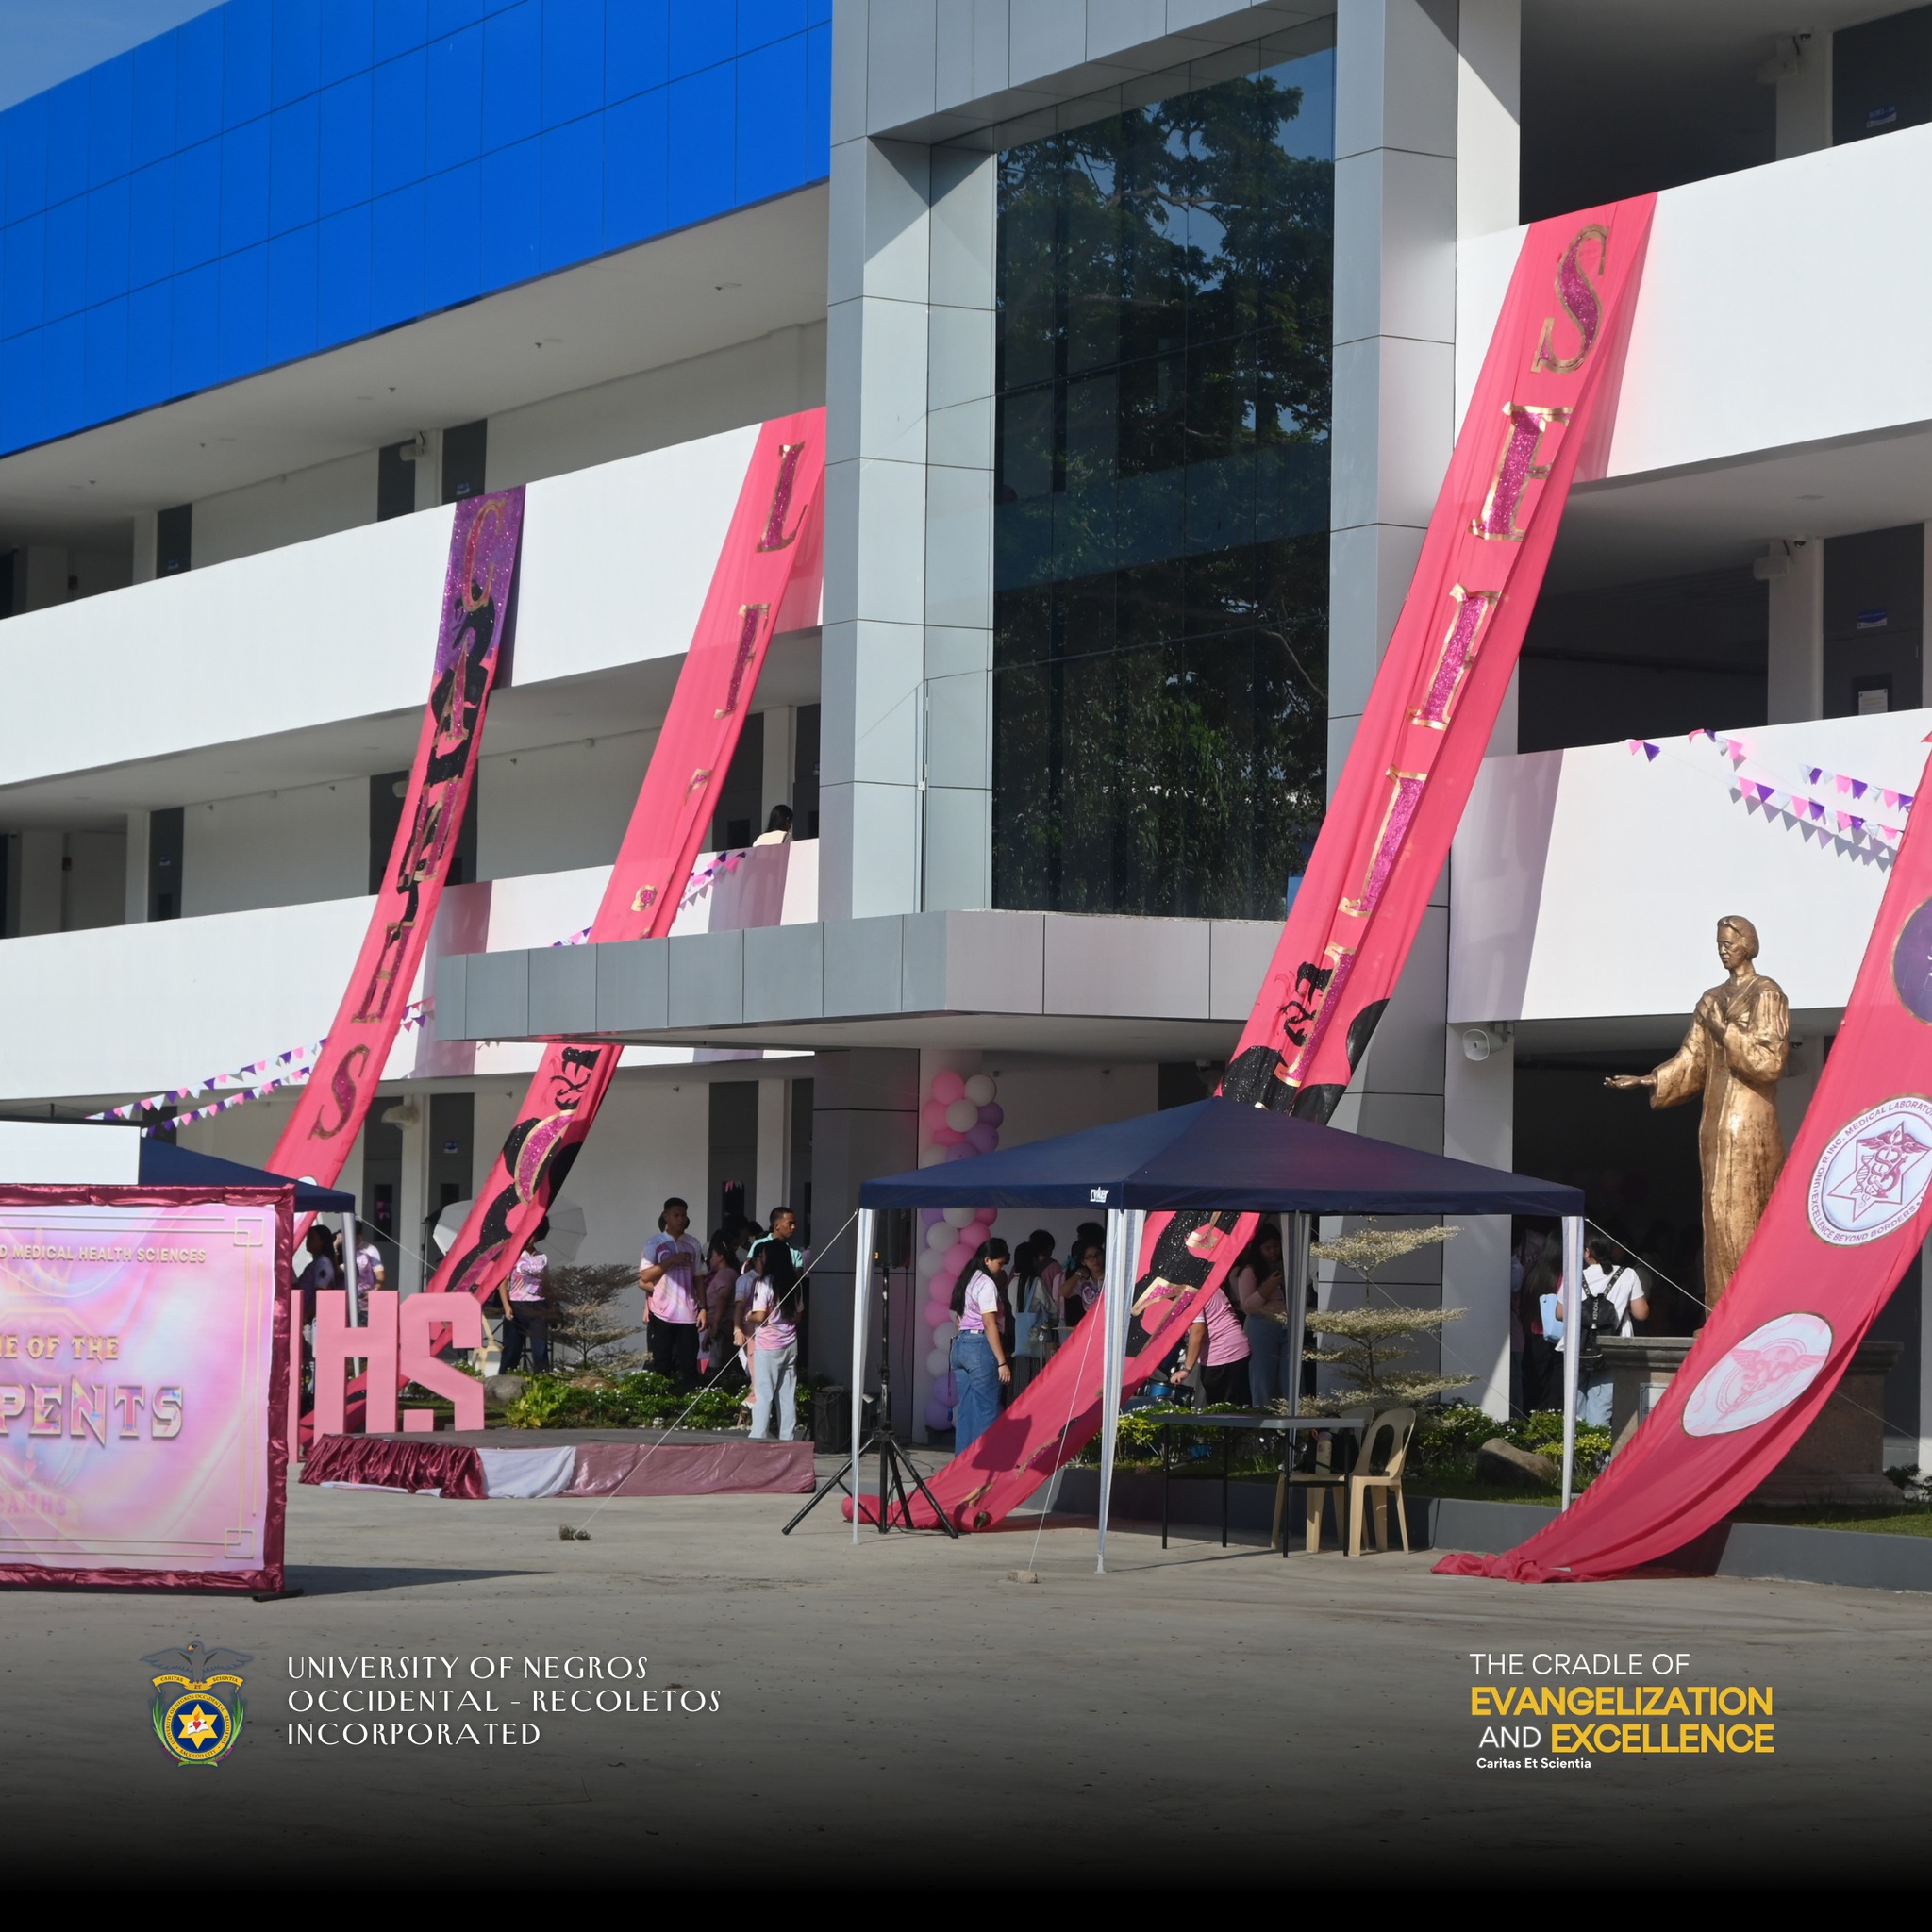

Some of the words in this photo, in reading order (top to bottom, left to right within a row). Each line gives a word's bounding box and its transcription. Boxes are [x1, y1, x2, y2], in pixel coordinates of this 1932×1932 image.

[1828, 1138, 1846, 1155] INC.
[1844, 1108, 1887, 1137] MEDICAL
[1889, 1100, 1932, 1119] LABORATO
[1811, 1193, 1834, 1239] EXCELLENCE
[1833, 1233, 1869, 1242] BEYOND
[1870, 1205, 1917, 1238] BORDERS
[13, 1245, 74, 1260] MEDICAL
[79, 1246, 132, 1262] HEALTH
[137, 1248, 207, 1263] SCIENCES
[26, 1336, 60, 1359] OF
[72, 1336, 119, 1364] THE
